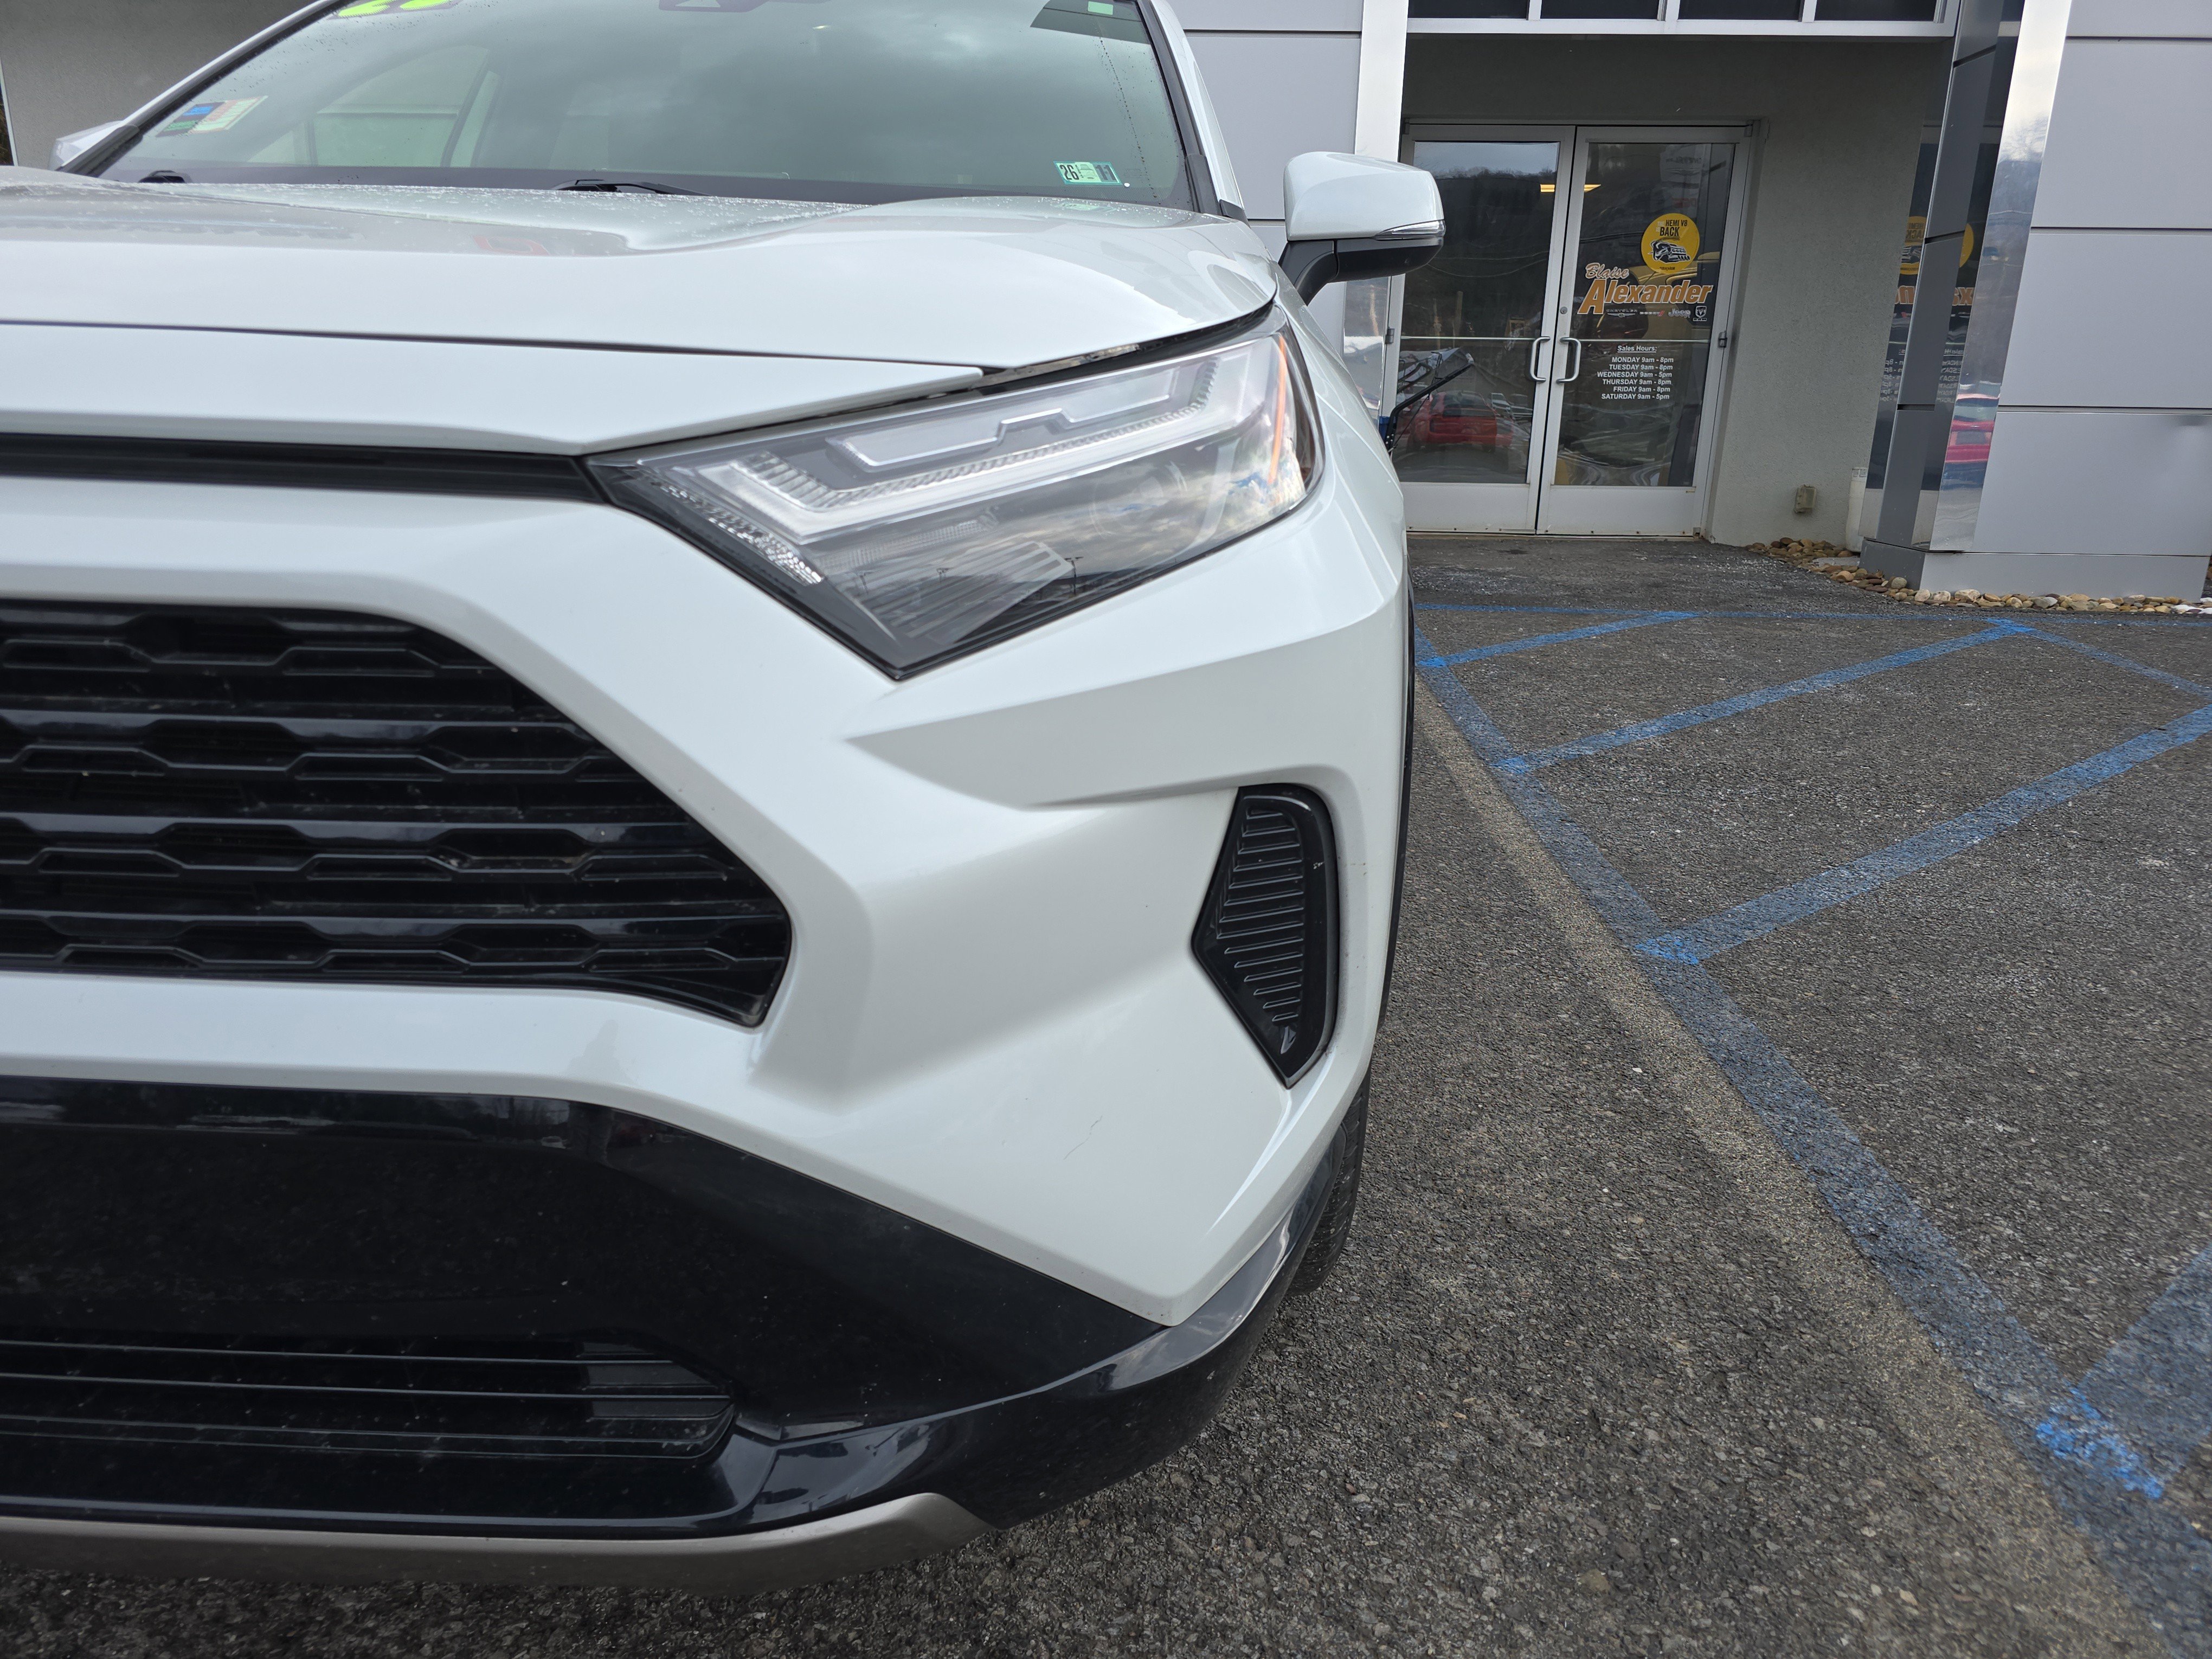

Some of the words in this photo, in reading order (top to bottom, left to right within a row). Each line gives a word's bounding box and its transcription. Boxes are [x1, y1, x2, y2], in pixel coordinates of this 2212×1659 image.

[1059, 164, 1079, 180] 26
[1095, 164, 1116, 181] 11
[1660, 227, 1680, 236] BACK
[1585, 262, 1629, 279] Blaise
[1577, 279, 1713, 314] Alexander
[1668, 308, 1690, 318] Jeep
